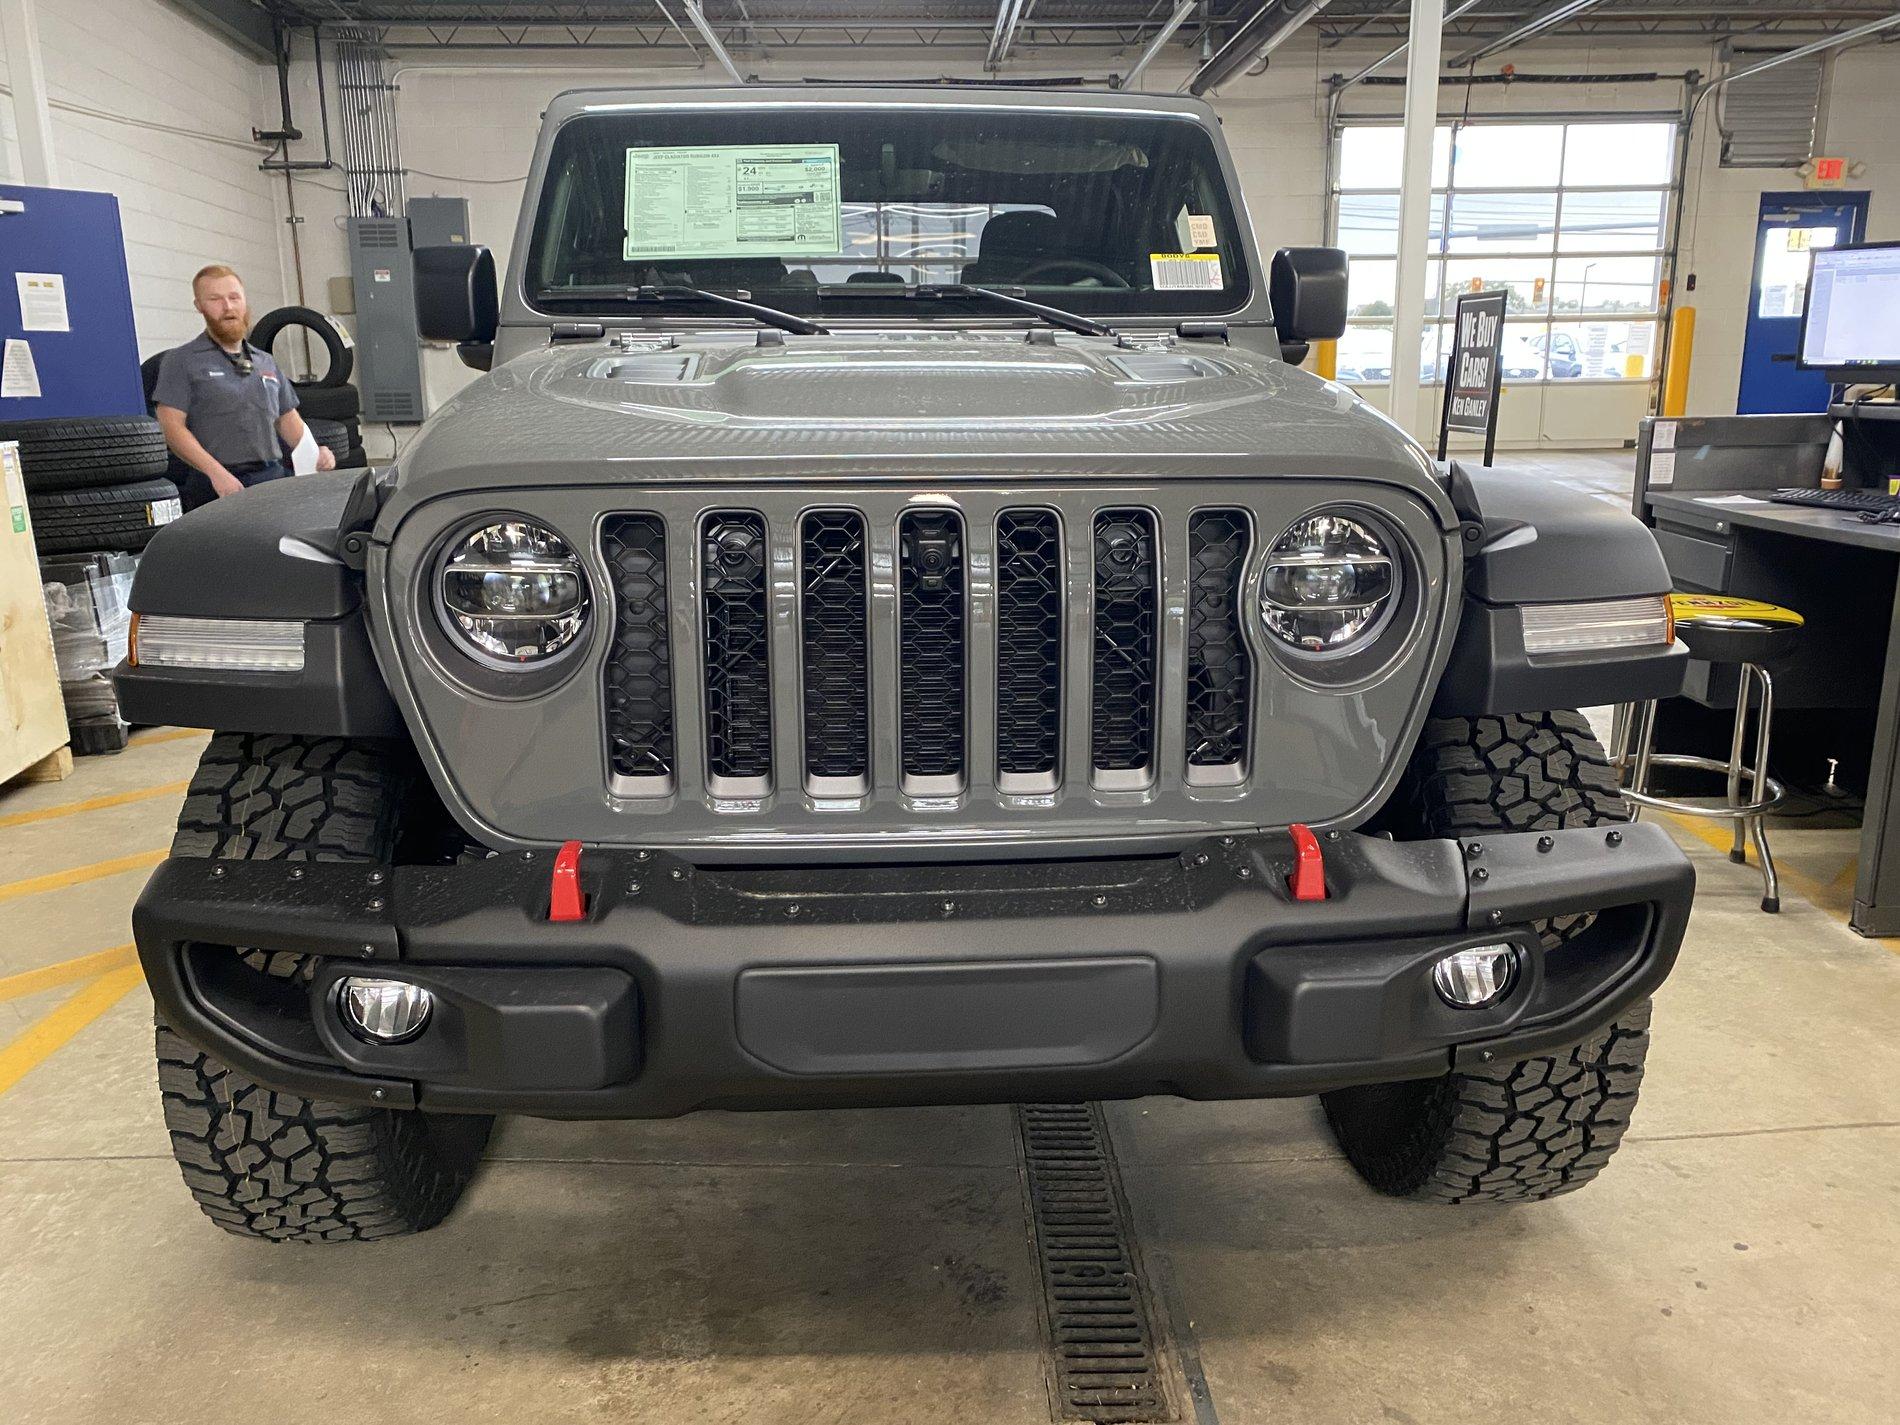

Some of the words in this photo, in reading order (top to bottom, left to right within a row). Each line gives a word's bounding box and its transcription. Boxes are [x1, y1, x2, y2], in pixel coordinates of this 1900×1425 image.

[743, 167, 757, 175] 24
[1461, 312, 1478, 348] WE
[1476, 311, 1498, 348] BUY
[1459, 351, 1489, 388] CARS!
[1452, 396, 1465, 416] KEN
[1463, 396, 1487, 417] GANLEY
